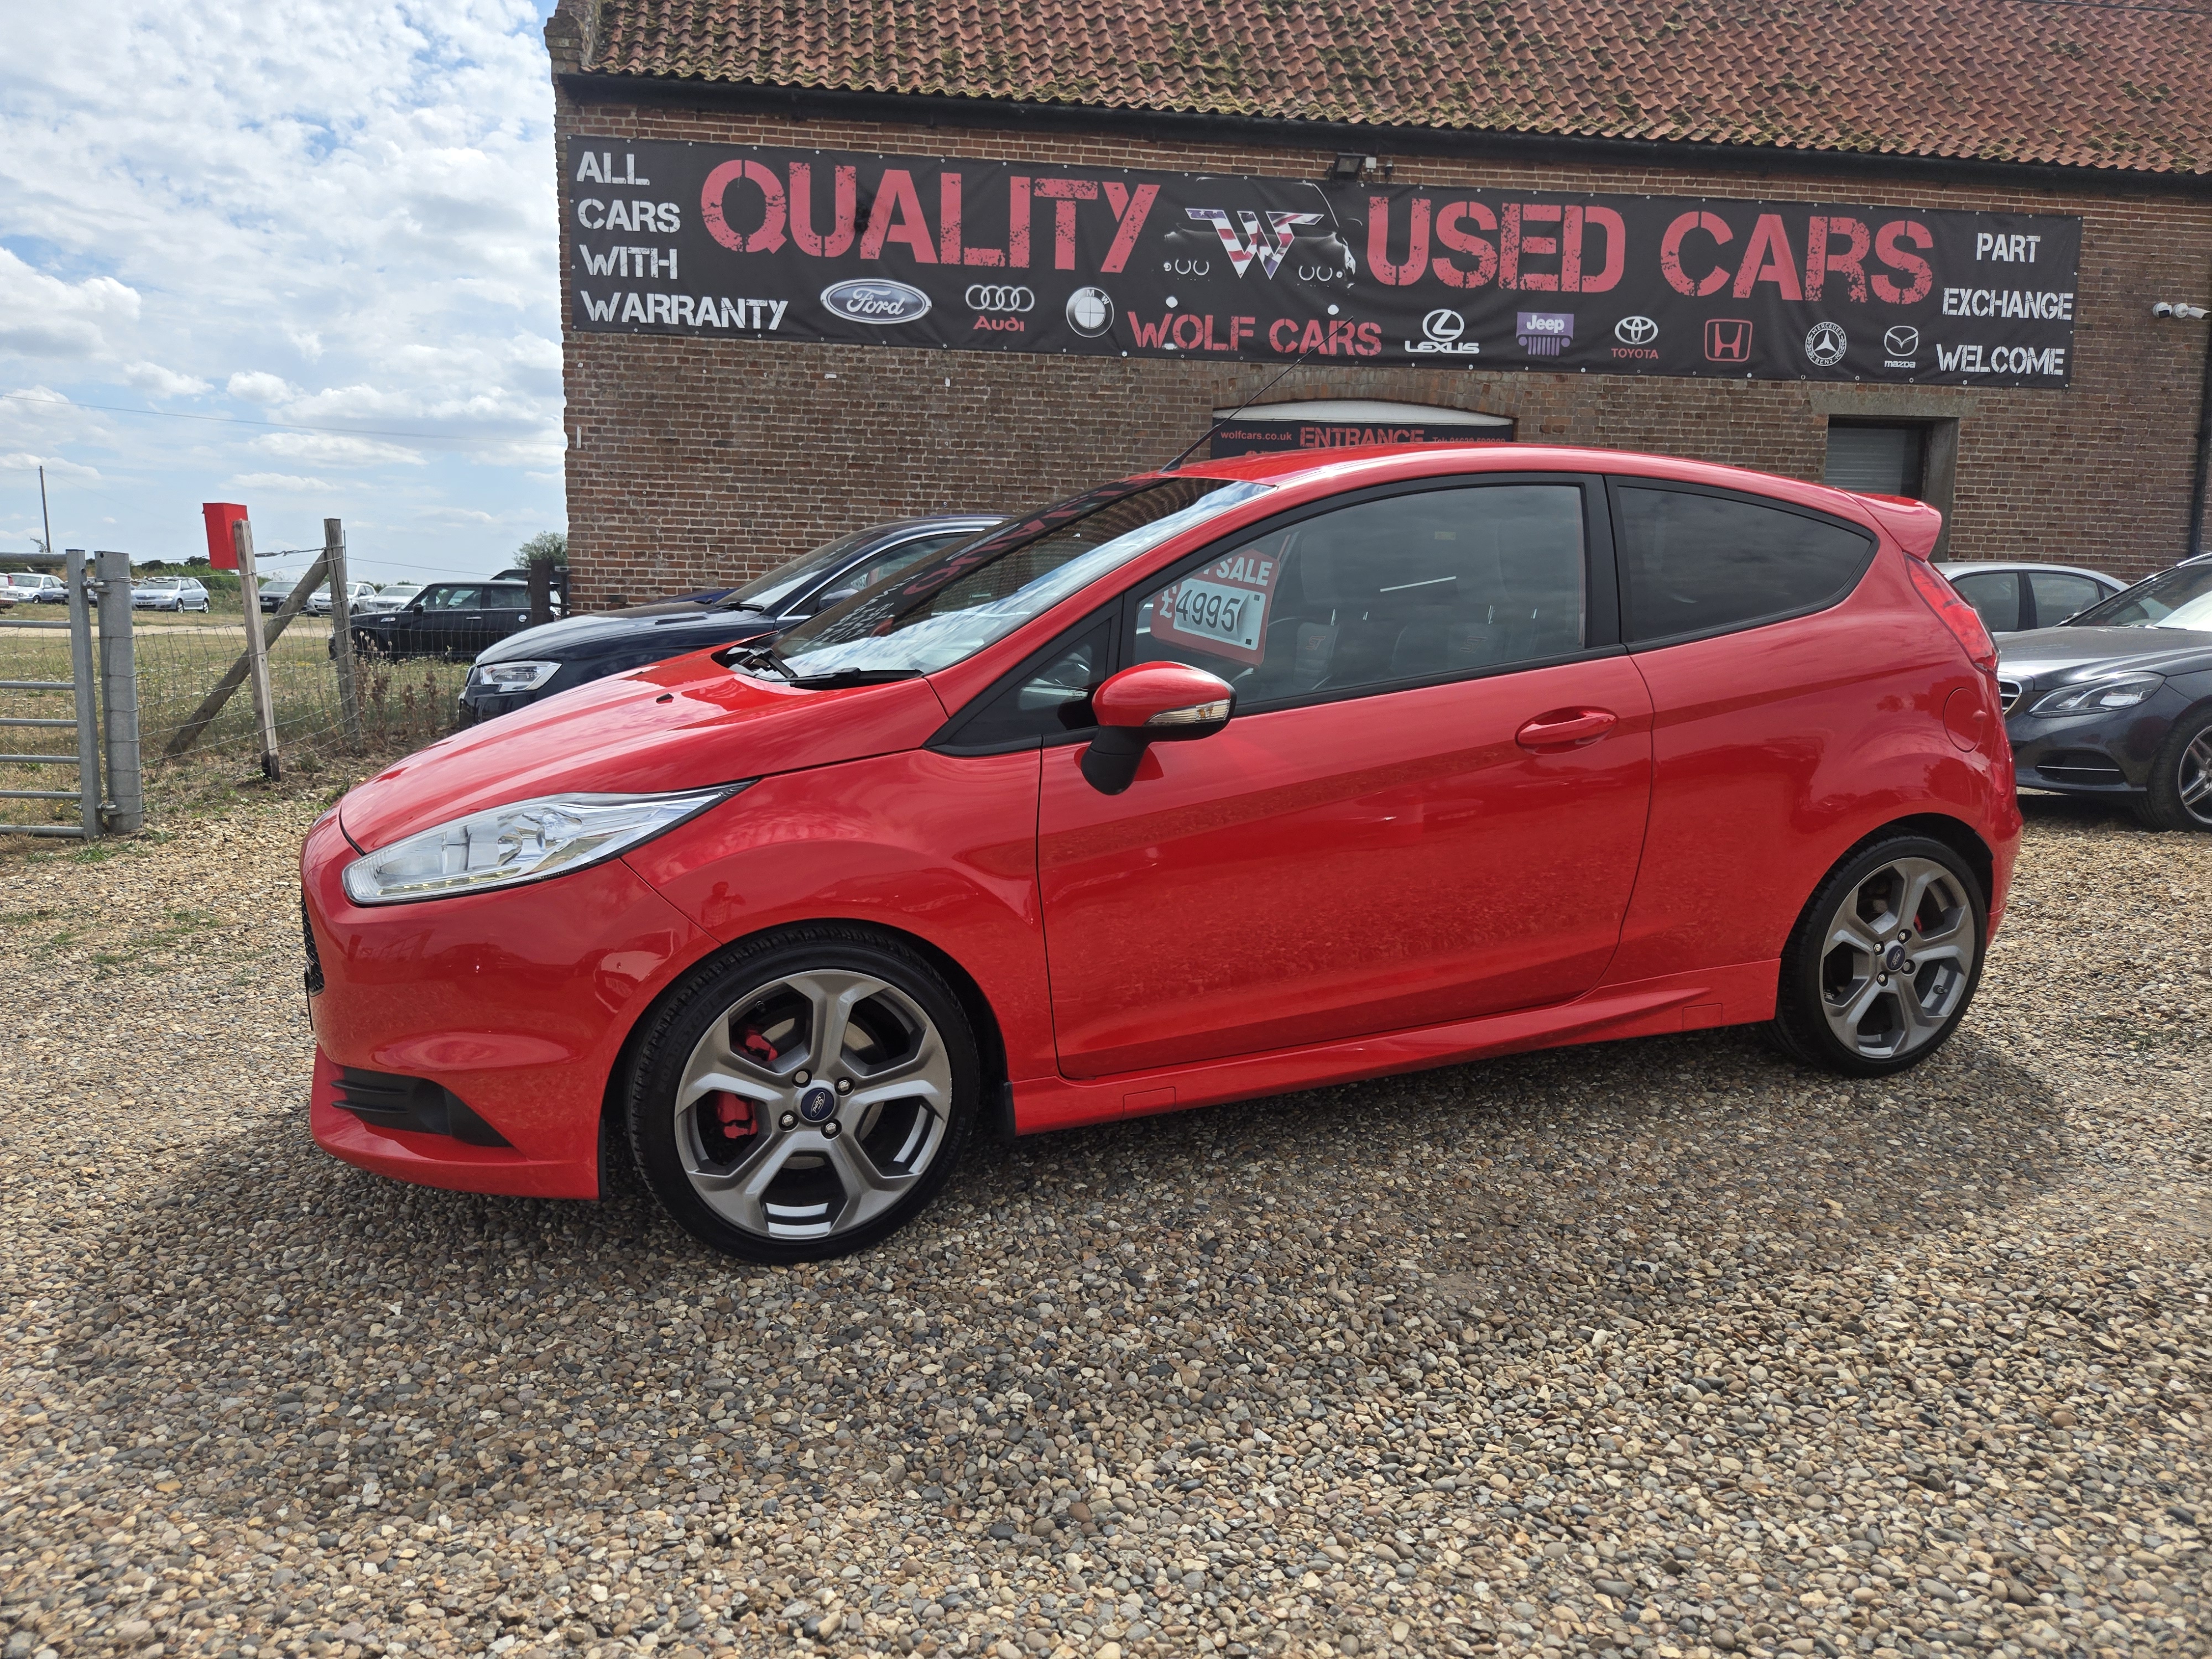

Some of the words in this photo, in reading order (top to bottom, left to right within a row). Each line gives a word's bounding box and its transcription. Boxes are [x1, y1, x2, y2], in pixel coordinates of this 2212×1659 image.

[576, 152, 650, 185] ALL
[577, 199, 681, 233] CARS
[701, 159, 1161, 273] QUALITY
[579, 244, 678, 279] WITH
[1367, 196, 1625, 293] USED
[1660, 211, 1934, 305] CARS
[1976, 233, 2041, 263] PART
[580, 290, 789, 330] WARRANTY
[846, 288, 904, 316] Ford
[1943, 288, 2073, 321] EXCHANGE
[973, 316, 1025, 332] Audi
[1128, 311, 1256, 351] WOLF
[1269, 319, 1381, 357] CARS
[1526, 315, 1565, 333] Jeep
[1812, 324, 1843, 336] MERCEDES
[1405, 340, 1480, 354] LEXUS
[1611, 348, 1659, 359] TOYOTA
[1936, 343, 2065, 375] WELCOME
[1220, 431, 1292, 441] wolfcars.co.uk
[1300, 427, 1425, 448] ENTRANCE
[1216, 557, 1273, 587] SALE
[1305, 635, 1326, 650] ST
[812, 1095, 823, 1114] Ford
